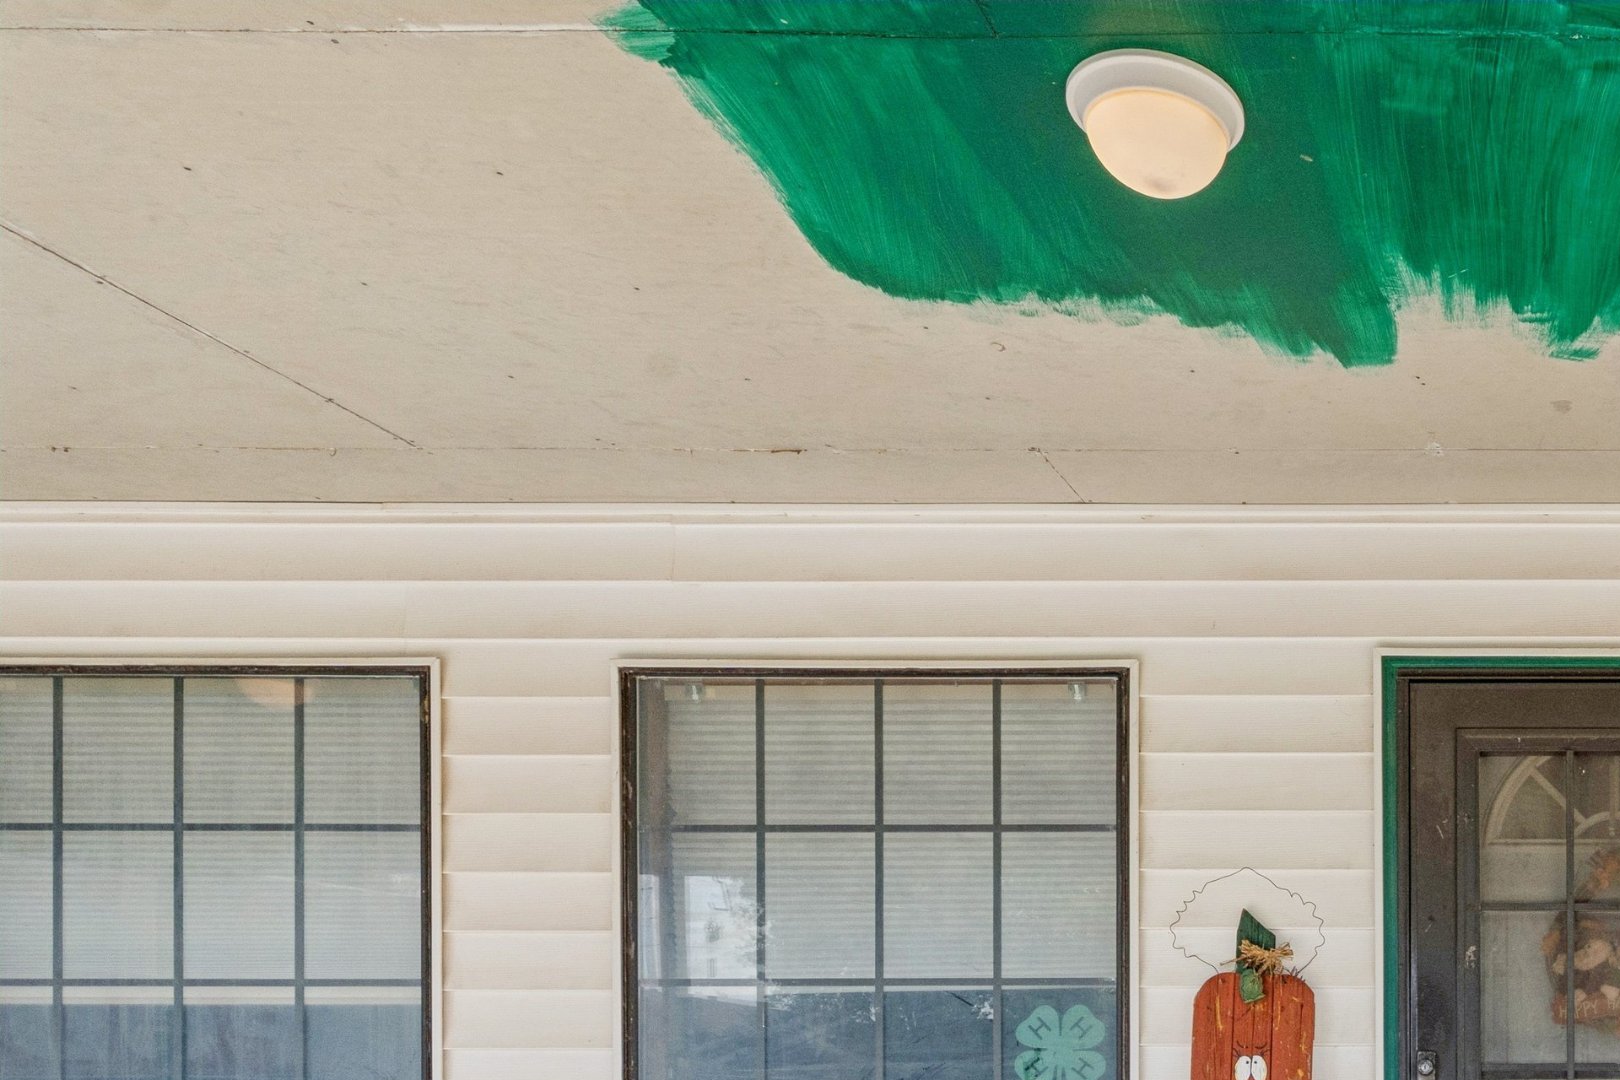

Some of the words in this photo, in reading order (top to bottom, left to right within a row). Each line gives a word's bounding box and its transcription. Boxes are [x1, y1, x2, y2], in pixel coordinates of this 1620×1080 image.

[1559, 999, 1598, 1019] HPPY
[1028, 1016, 1052, 1040] H
[1070, 1016, 1093, 1040] H
[1071, 1057, 1095, 1080] H
